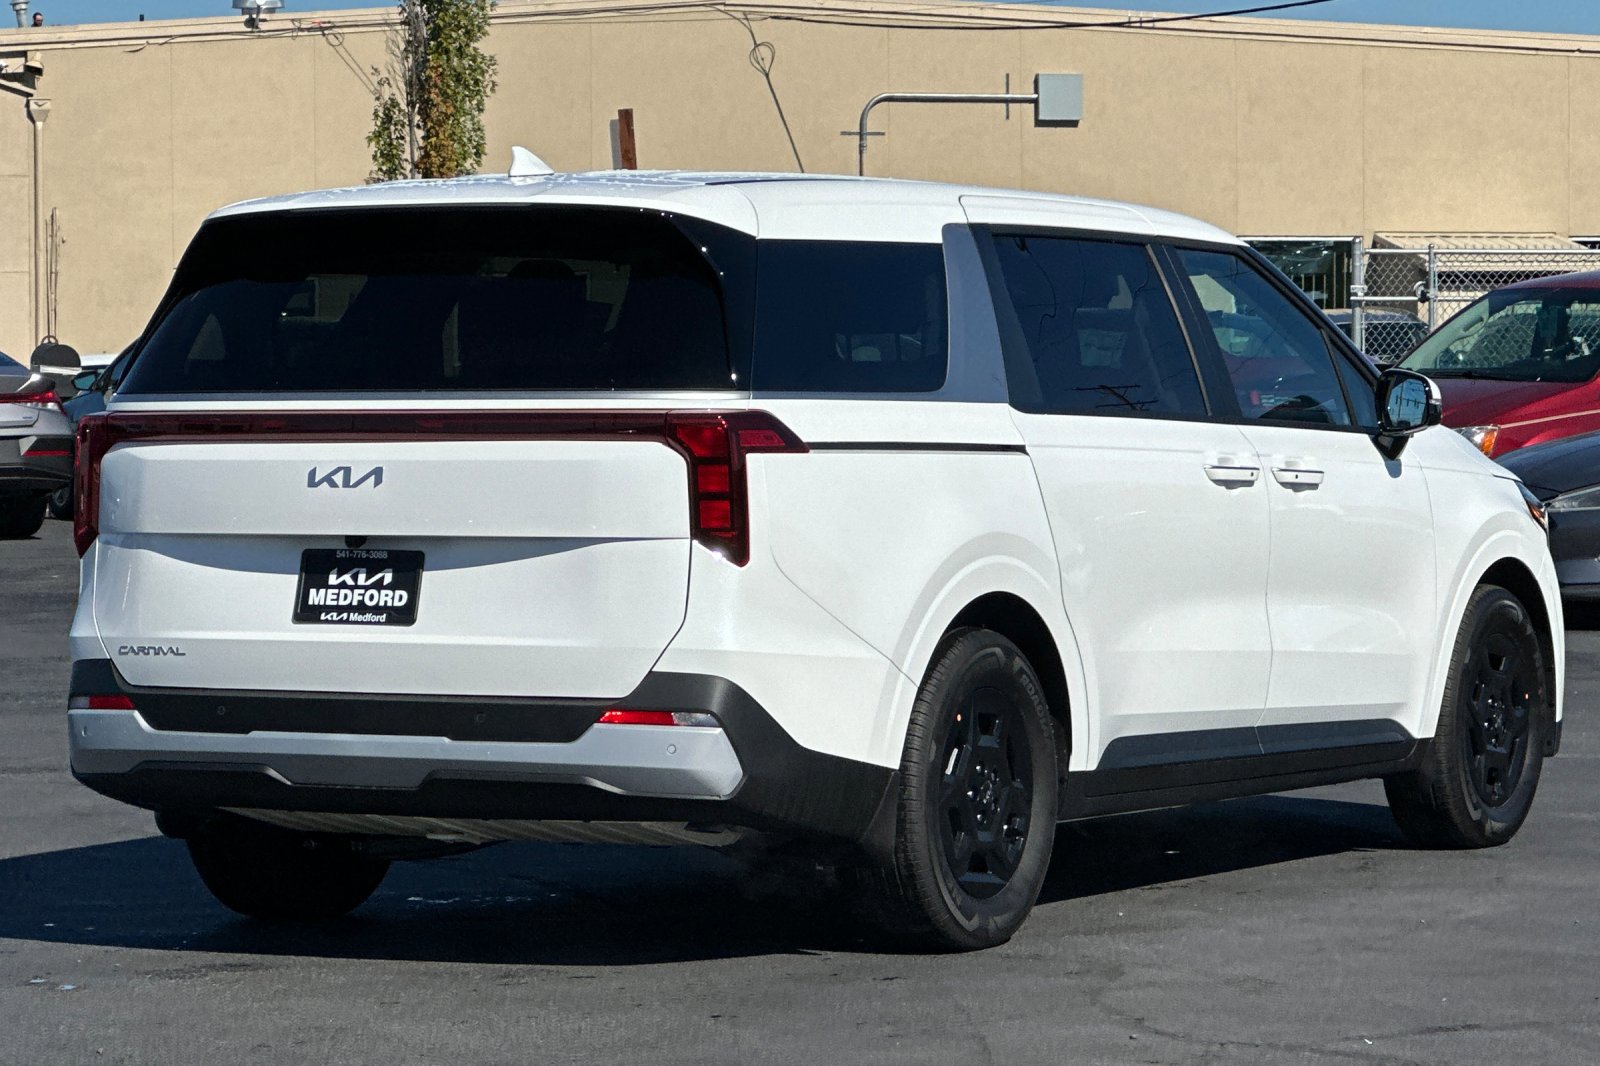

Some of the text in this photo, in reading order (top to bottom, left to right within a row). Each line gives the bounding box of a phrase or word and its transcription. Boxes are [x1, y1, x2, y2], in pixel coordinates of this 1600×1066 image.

[307, 466, 383, 488] KIA
[328, 567, 393, 586] KIA
[308, 588, 408, 607] MEDFORD
[349, 612, 387, 622] Medford
[118, 645, 186, 656] CARNIVAL
